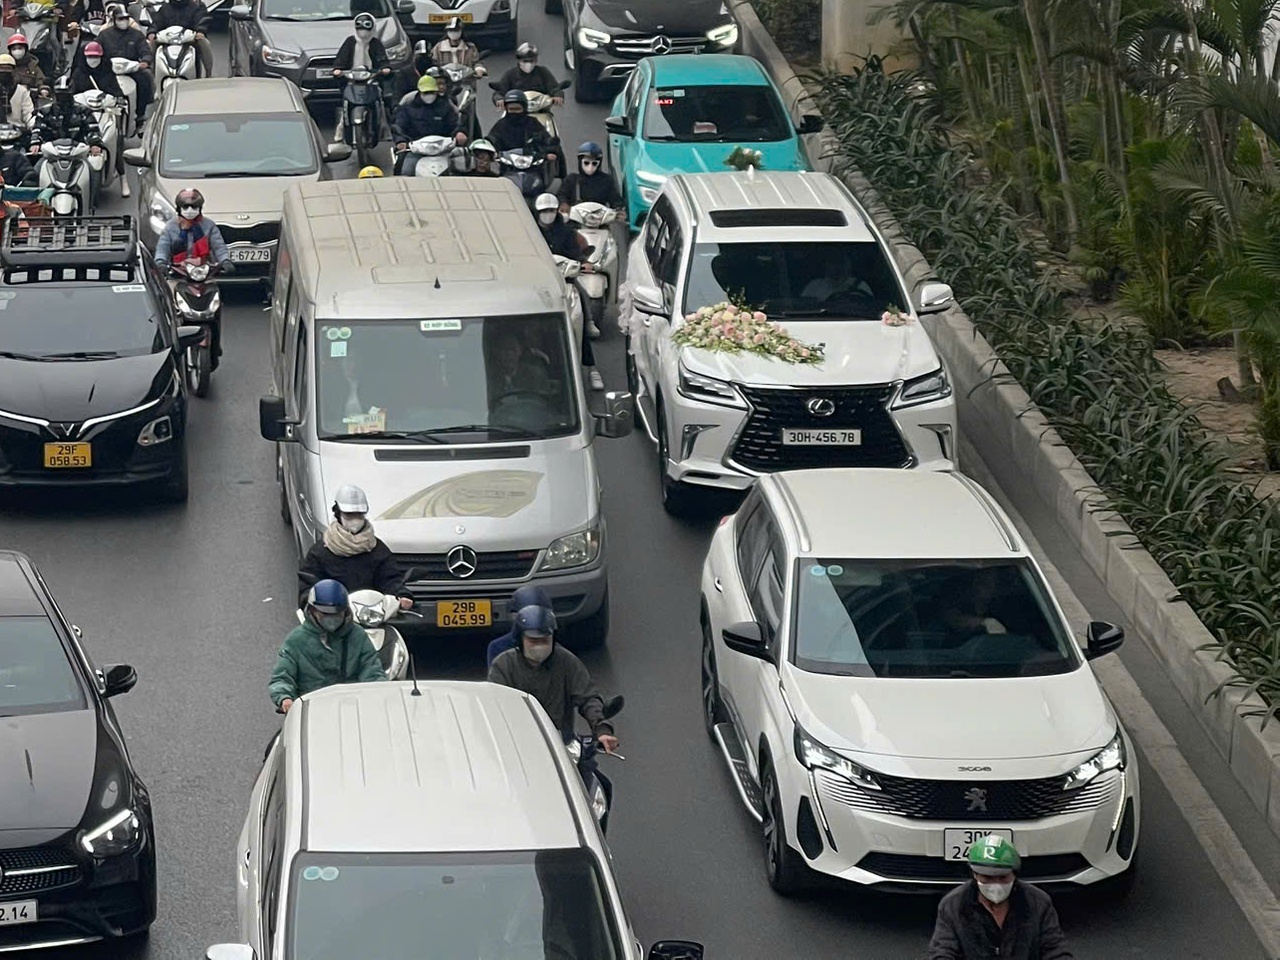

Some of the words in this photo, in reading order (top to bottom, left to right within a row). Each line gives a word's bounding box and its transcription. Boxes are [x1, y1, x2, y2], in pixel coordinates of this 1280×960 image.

[789, 431, 855, 443] 30H-456.78
[58, 445, 77, 455] 29F
[50, 456, 87, 466] 058.53
[452, 601, 476, 614] 29B
[443, 614, 486, 626] 045.99
